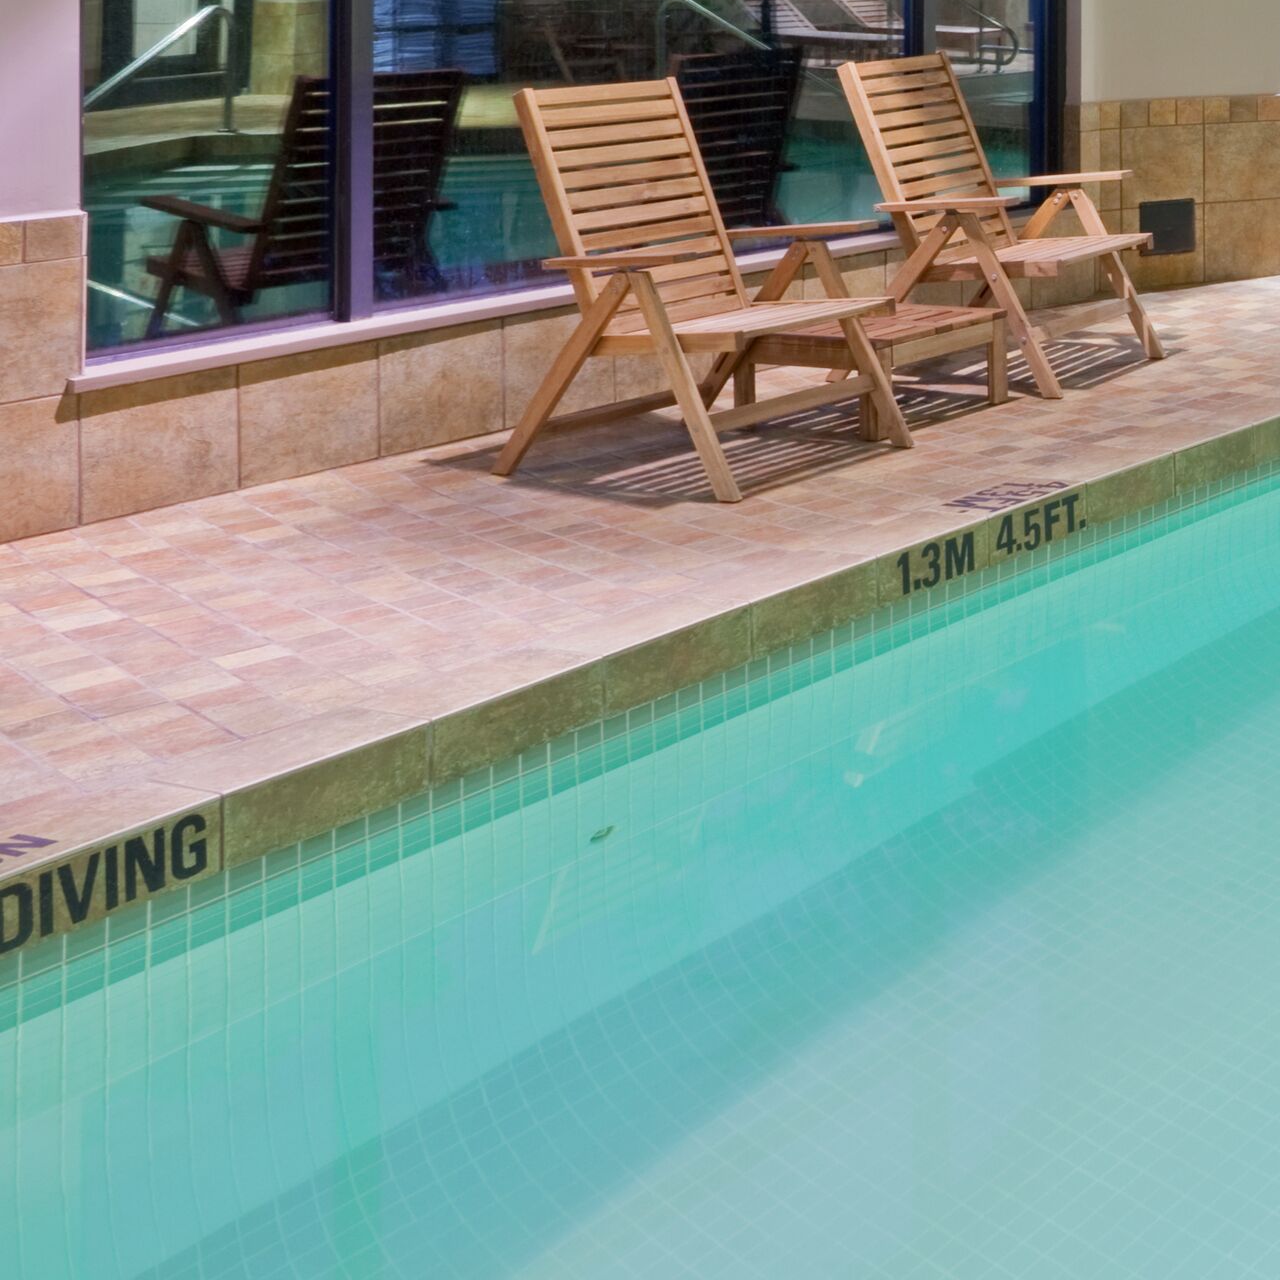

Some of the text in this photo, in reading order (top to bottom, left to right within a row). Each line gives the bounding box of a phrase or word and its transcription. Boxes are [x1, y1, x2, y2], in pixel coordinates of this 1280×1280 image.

[896, 493, 1086, 595] 1.3M 4.5FT.
[0, 814, 208, 955] DIVING
